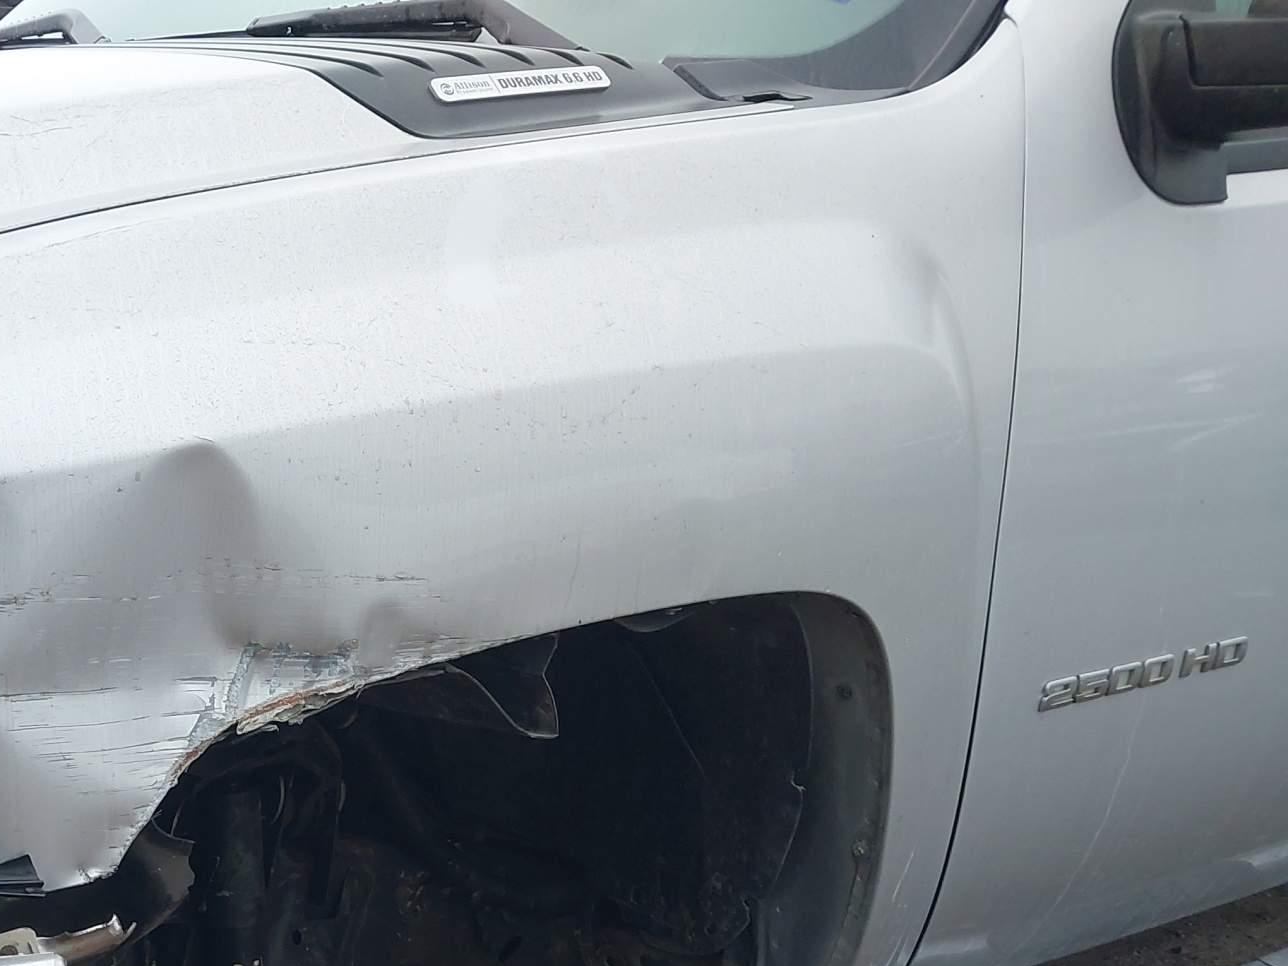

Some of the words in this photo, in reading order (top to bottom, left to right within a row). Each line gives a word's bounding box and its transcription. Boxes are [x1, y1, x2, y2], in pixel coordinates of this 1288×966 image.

[454, 80, 490, 91] Allison
[497, 74, 562, 89] DURAMAX
[562, 72, 584, 84] 6.6
[583, 71, 603, 82] HD
[1038, 653, 1175, 712] 2500
[1178, 636, 1249, 678] HD
